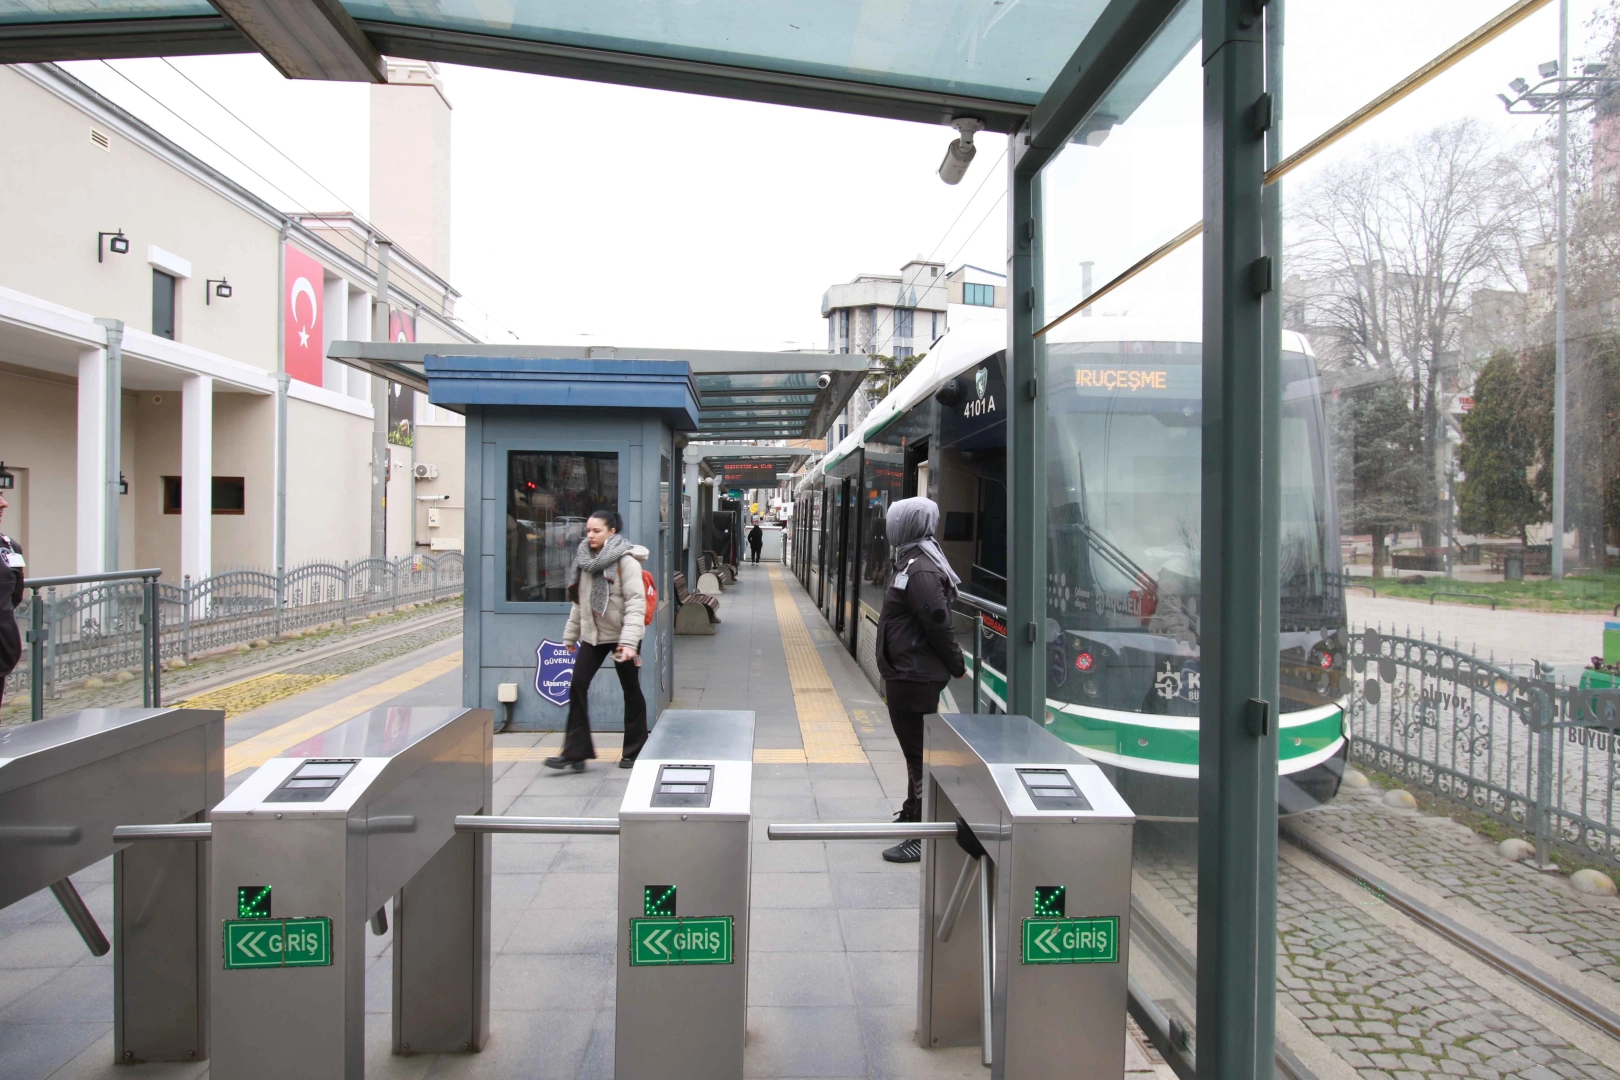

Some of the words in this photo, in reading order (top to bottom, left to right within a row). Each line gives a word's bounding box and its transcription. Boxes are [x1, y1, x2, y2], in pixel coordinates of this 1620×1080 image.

[553, 648, 571, 656] ÖZEL
[268, 929, 318, 956] GRİŞ
[673, 928, 720, 954] GİRİŞ
[1062, 927, 1107, 952] GİRİŞ
